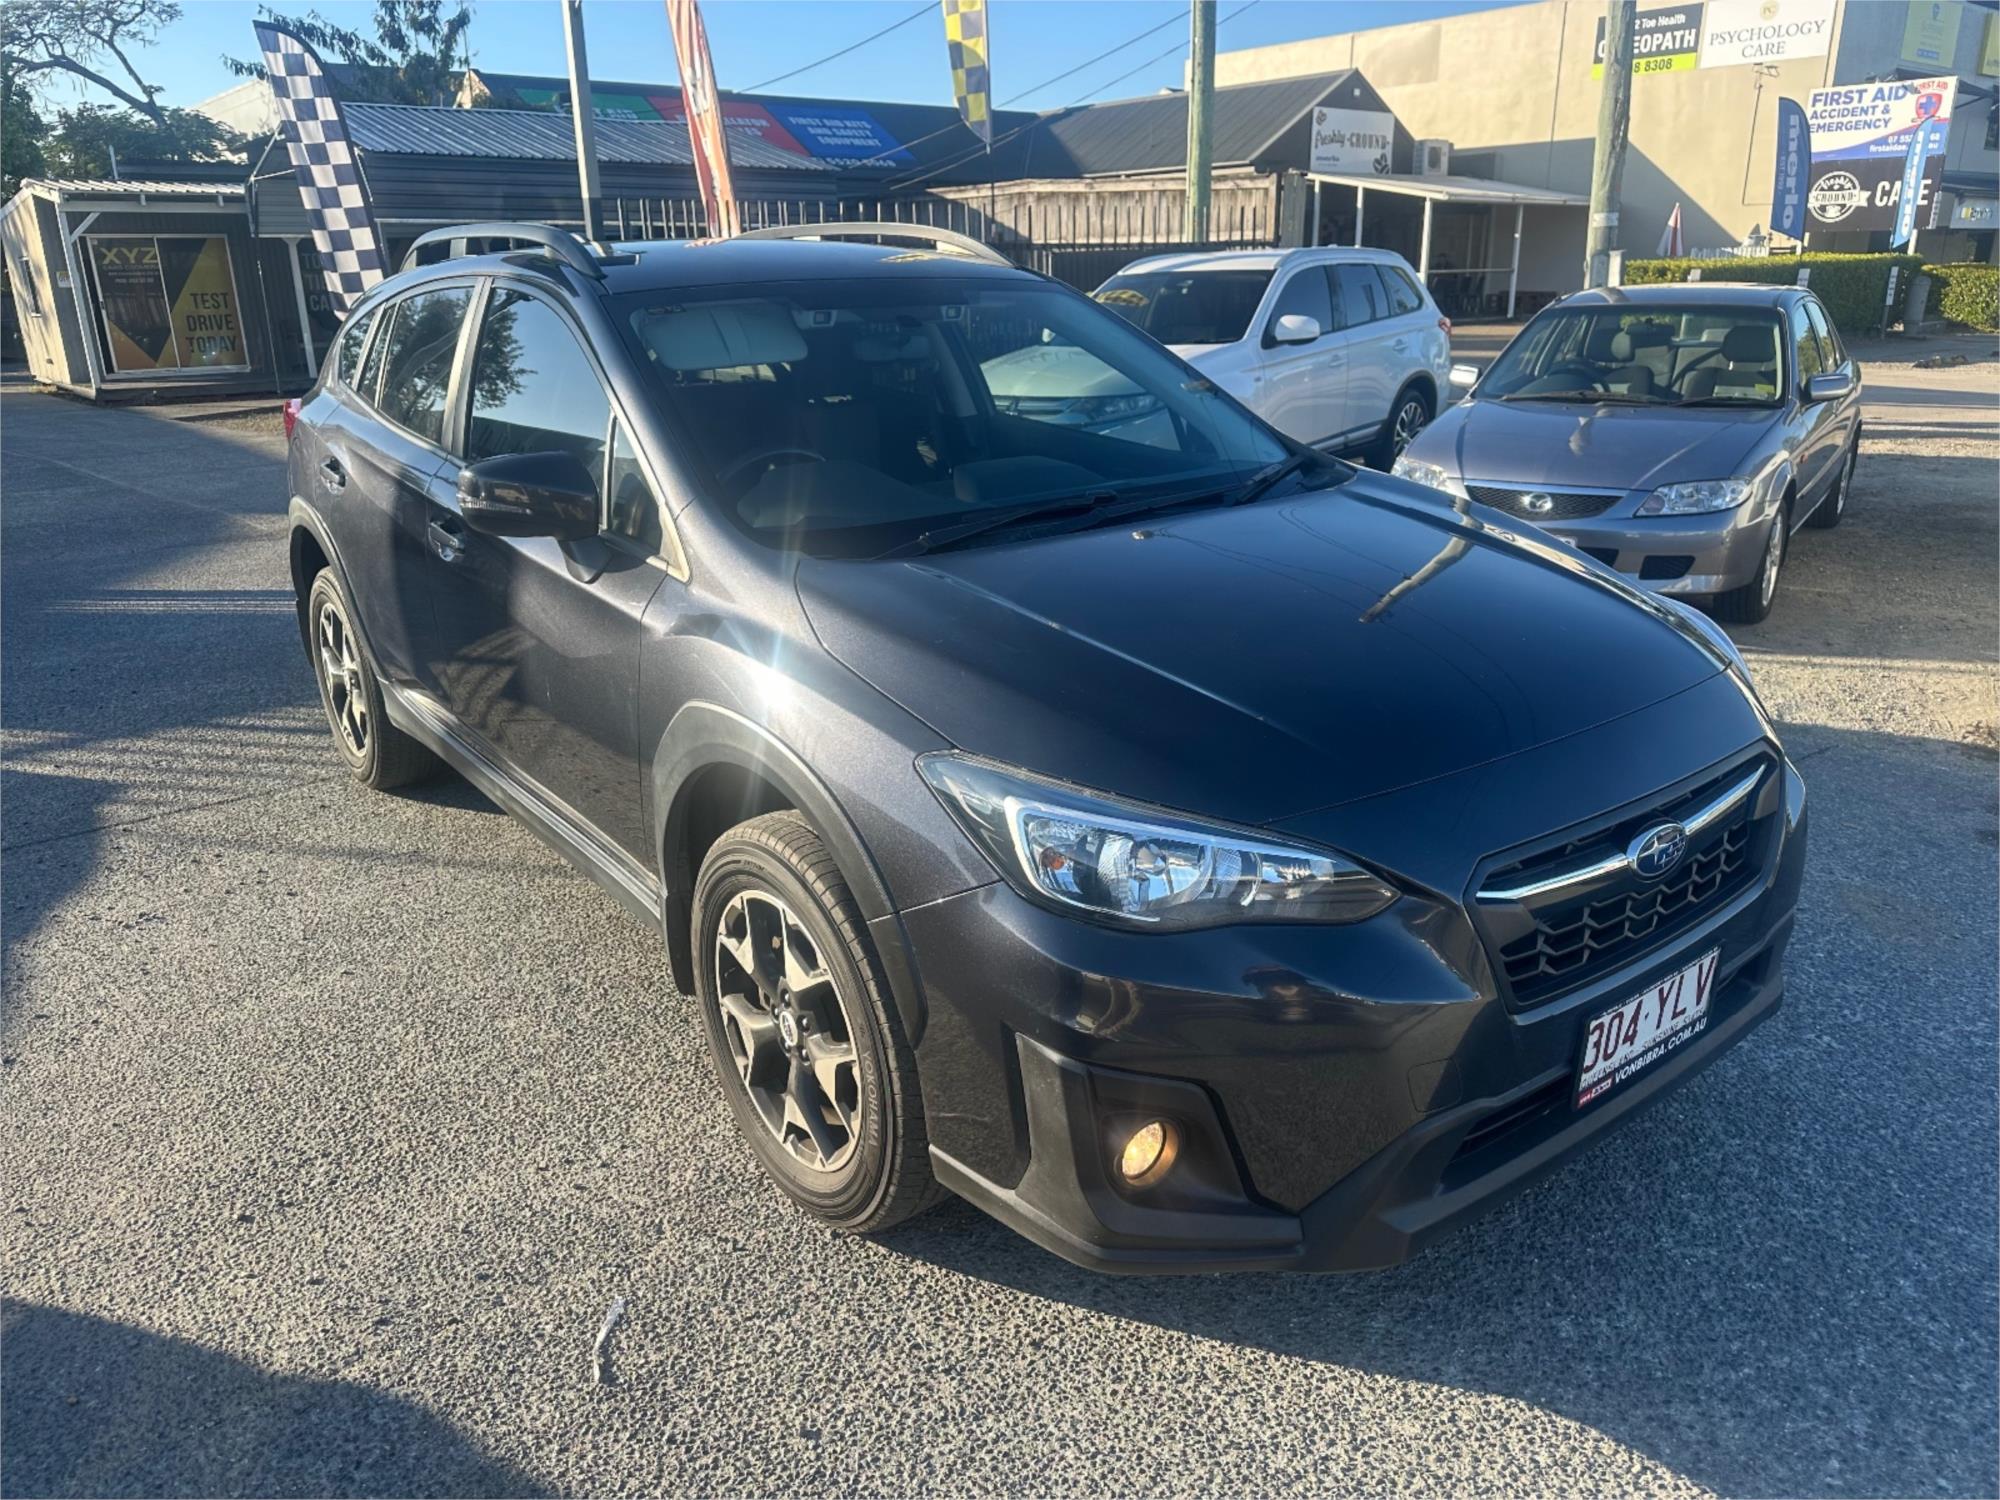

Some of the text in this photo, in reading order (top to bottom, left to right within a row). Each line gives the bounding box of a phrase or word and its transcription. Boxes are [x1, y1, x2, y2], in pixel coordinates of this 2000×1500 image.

[1642, 18, 1656, 29] Toe
[1658, 13, 1686, 27] Health
[1710, 19, 1826, 46] PSYCHOLOGY
[1741, 41, 1786, 58] CARE
[1644, 58, 1673, 72] 8308
[1811, 86, 1906, 108] FIRST AID
[1809, 104, 1891, 120] ACCIDENT &
[1809, 118, 1892, 133] EMERGENCY
[1782, 114, 1799, 230] merlo
[1874, 178, 1932, 207] CAE
[101, 248, 159, 265] XYZ
[190, 292, 228, 310] TEST
[186, 313, 235, 332] DRIVE
[185, 335, 237, 353] TODAY
[1583, 999, 1643, 1074] 304
[862, 1050, 879, 1146] YOKOHAMA
